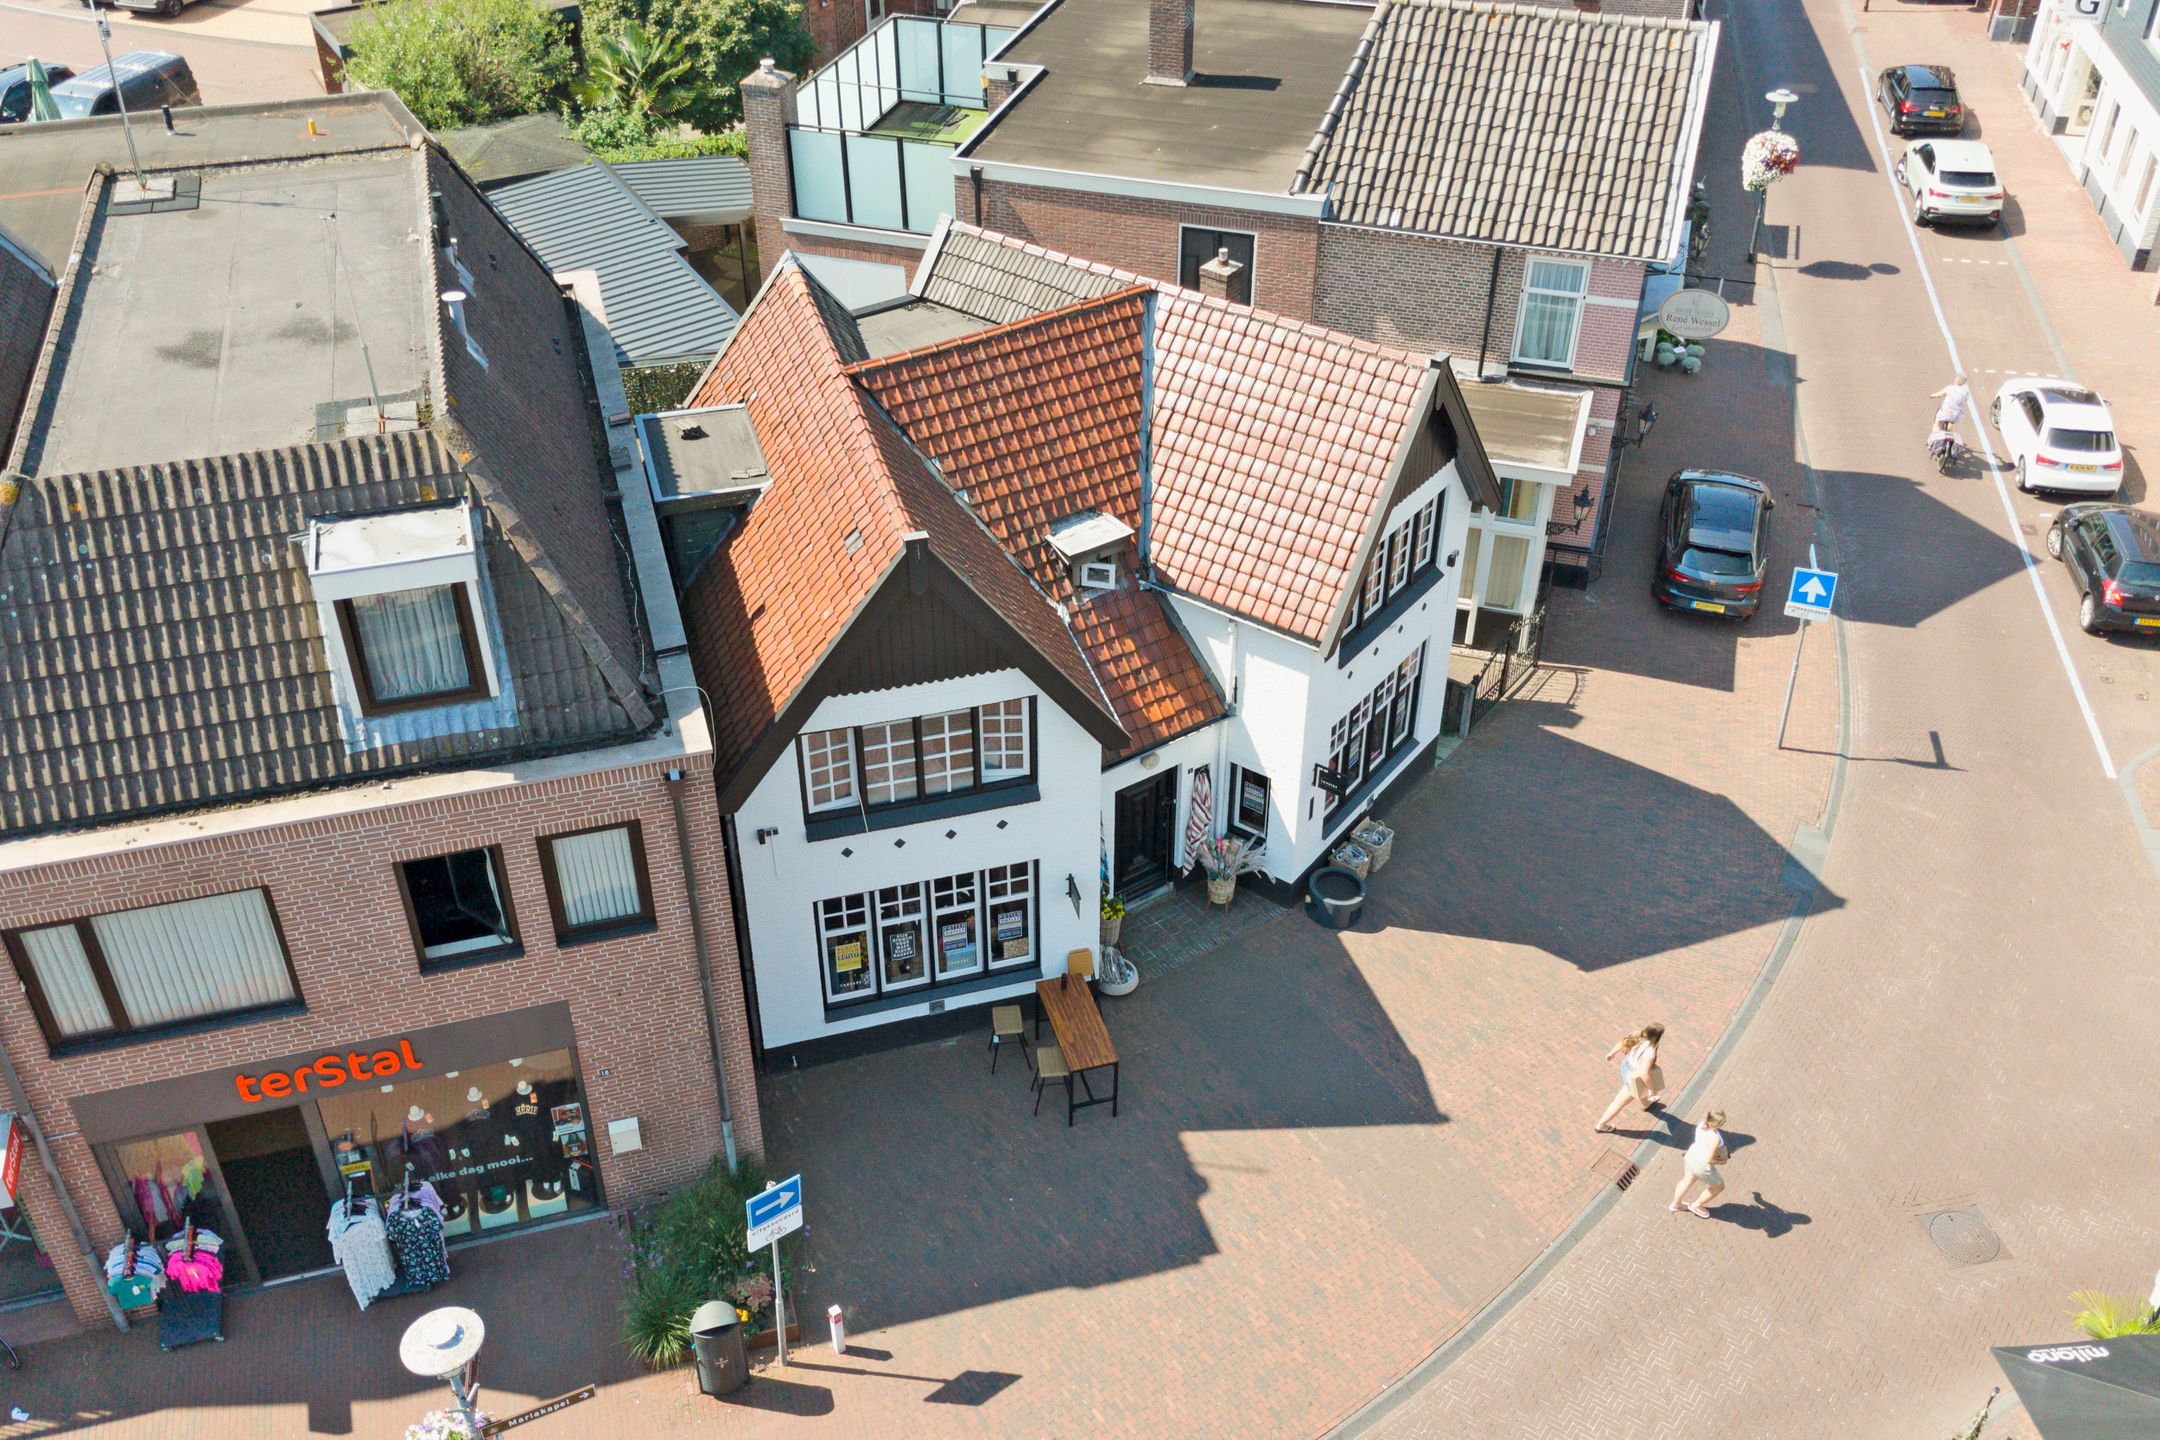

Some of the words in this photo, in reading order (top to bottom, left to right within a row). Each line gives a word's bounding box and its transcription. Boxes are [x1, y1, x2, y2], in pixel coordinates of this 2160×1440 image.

[1666, 313, 1688, 324] René
[1691, 316, 1721, 327] Wessel
[235, 1039, 423, 1103] terStal
[428, 1170, 456, 1182] elke
[459, 1163, 485, 1176] dag
[752, 1209, 799, 1236] uitgezonderd
[2027, 1346, 2110, 1363] milano
[508, 1399, 570, 1428] Mariakapel
